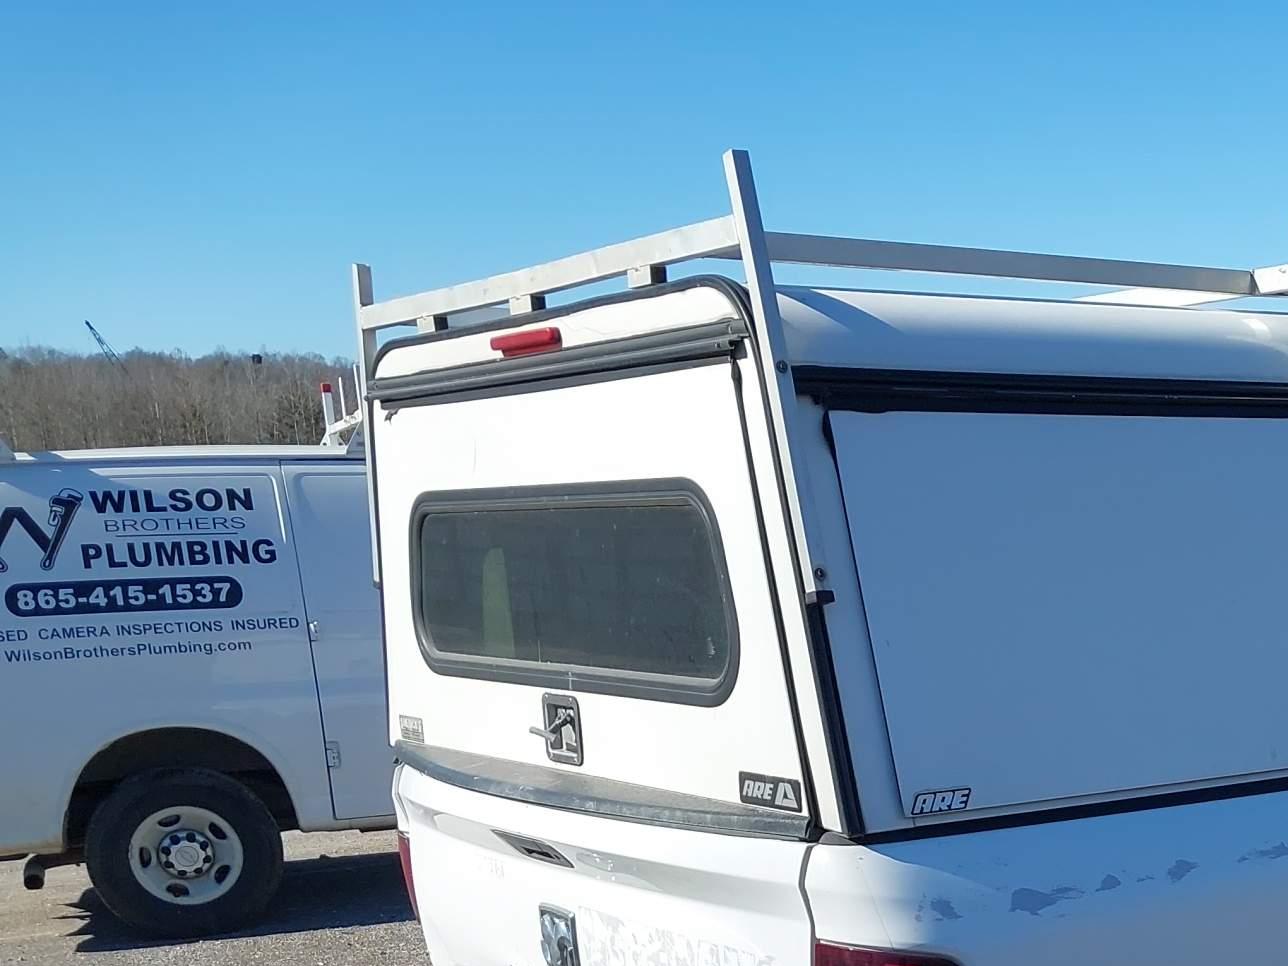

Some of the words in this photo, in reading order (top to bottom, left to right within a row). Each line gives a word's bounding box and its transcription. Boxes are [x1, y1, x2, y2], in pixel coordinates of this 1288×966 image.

[88, 488, 255, 514] WILSON
[104, 516, 246, 533] BROTHERS
[80, 538, 277, 569] PLUMBING
[16, 582, 231, 611] 865-415-1537
[38, 625, 111, 640] CAMERA
[116, 620, 223, 636] INSPECTIONS
[231, 617, 299, 631] INSURED
[4, 640, 252, 663] WilsonBrothersPlumbing.com
[742, 779, 774, 800] ARE
[911, 788, 971, 815] ARE
